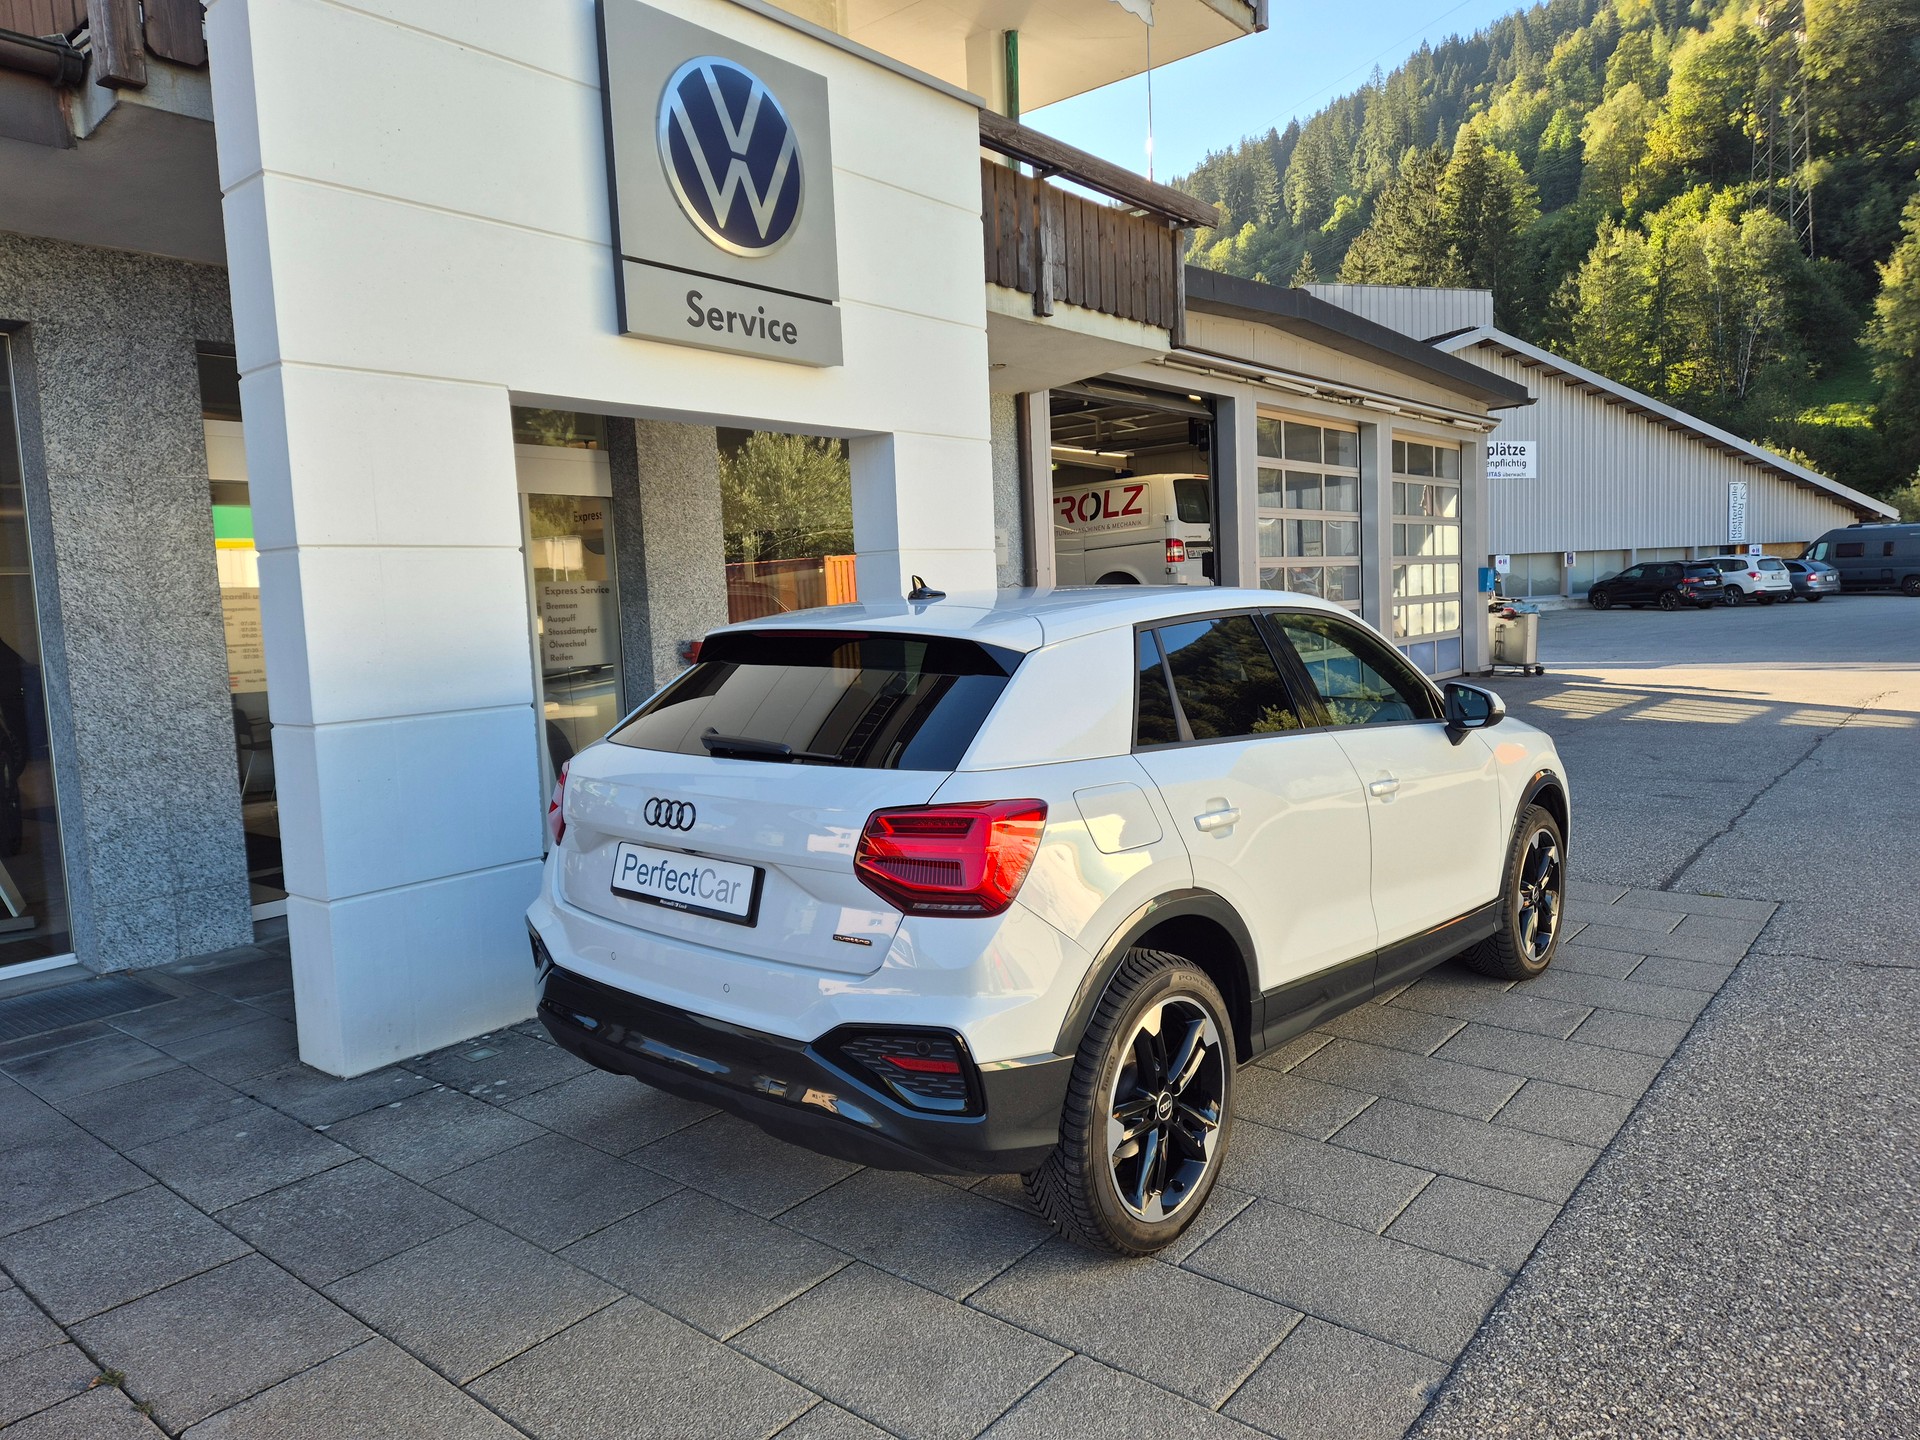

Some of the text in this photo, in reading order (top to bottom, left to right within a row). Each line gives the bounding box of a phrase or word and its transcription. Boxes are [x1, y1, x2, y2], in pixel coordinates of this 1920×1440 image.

[664, 58, 804, 252] VW
[686, 289, 798, 345] Service
[1487, 442, 1526, 459] plätze
[573, 511, 602, 525] Express
[1111, 519, 1142, 529] MECHANIK
[545, 585, 610, 597] Express Service
[546, 602, 578, 610] Bremsen
[547, 613, 577, 624] Auspuff
[548, 626, 598, 636] Stossdämpfer
[549, 639, 587, 649] Ölwechsel
[550, 653, 574, 662] Reifen
[622, 852, 742, 905] PerfectCar
